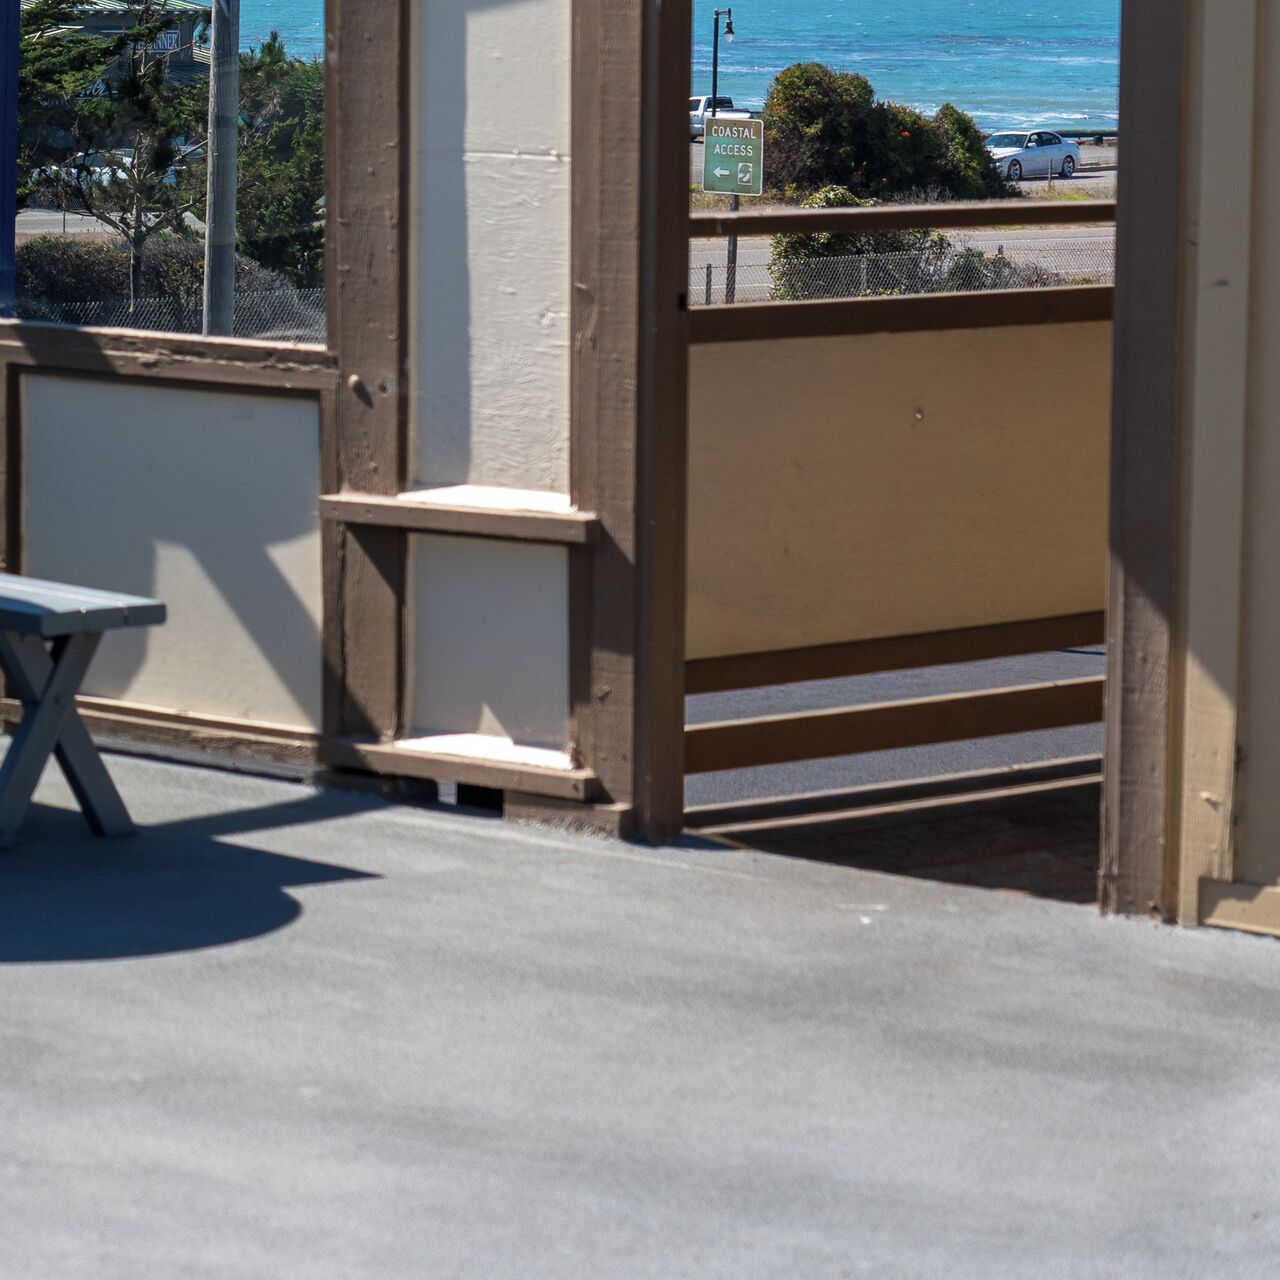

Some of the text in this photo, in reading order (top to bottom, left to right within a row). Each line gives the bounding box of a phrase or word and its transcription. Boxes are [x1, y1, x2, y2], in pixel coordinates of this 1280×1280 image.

[147, 34, 177, 49] INNER
[712, 126, 756, 139] COASTAL
[714, 144, 752, 156] ACCESS
